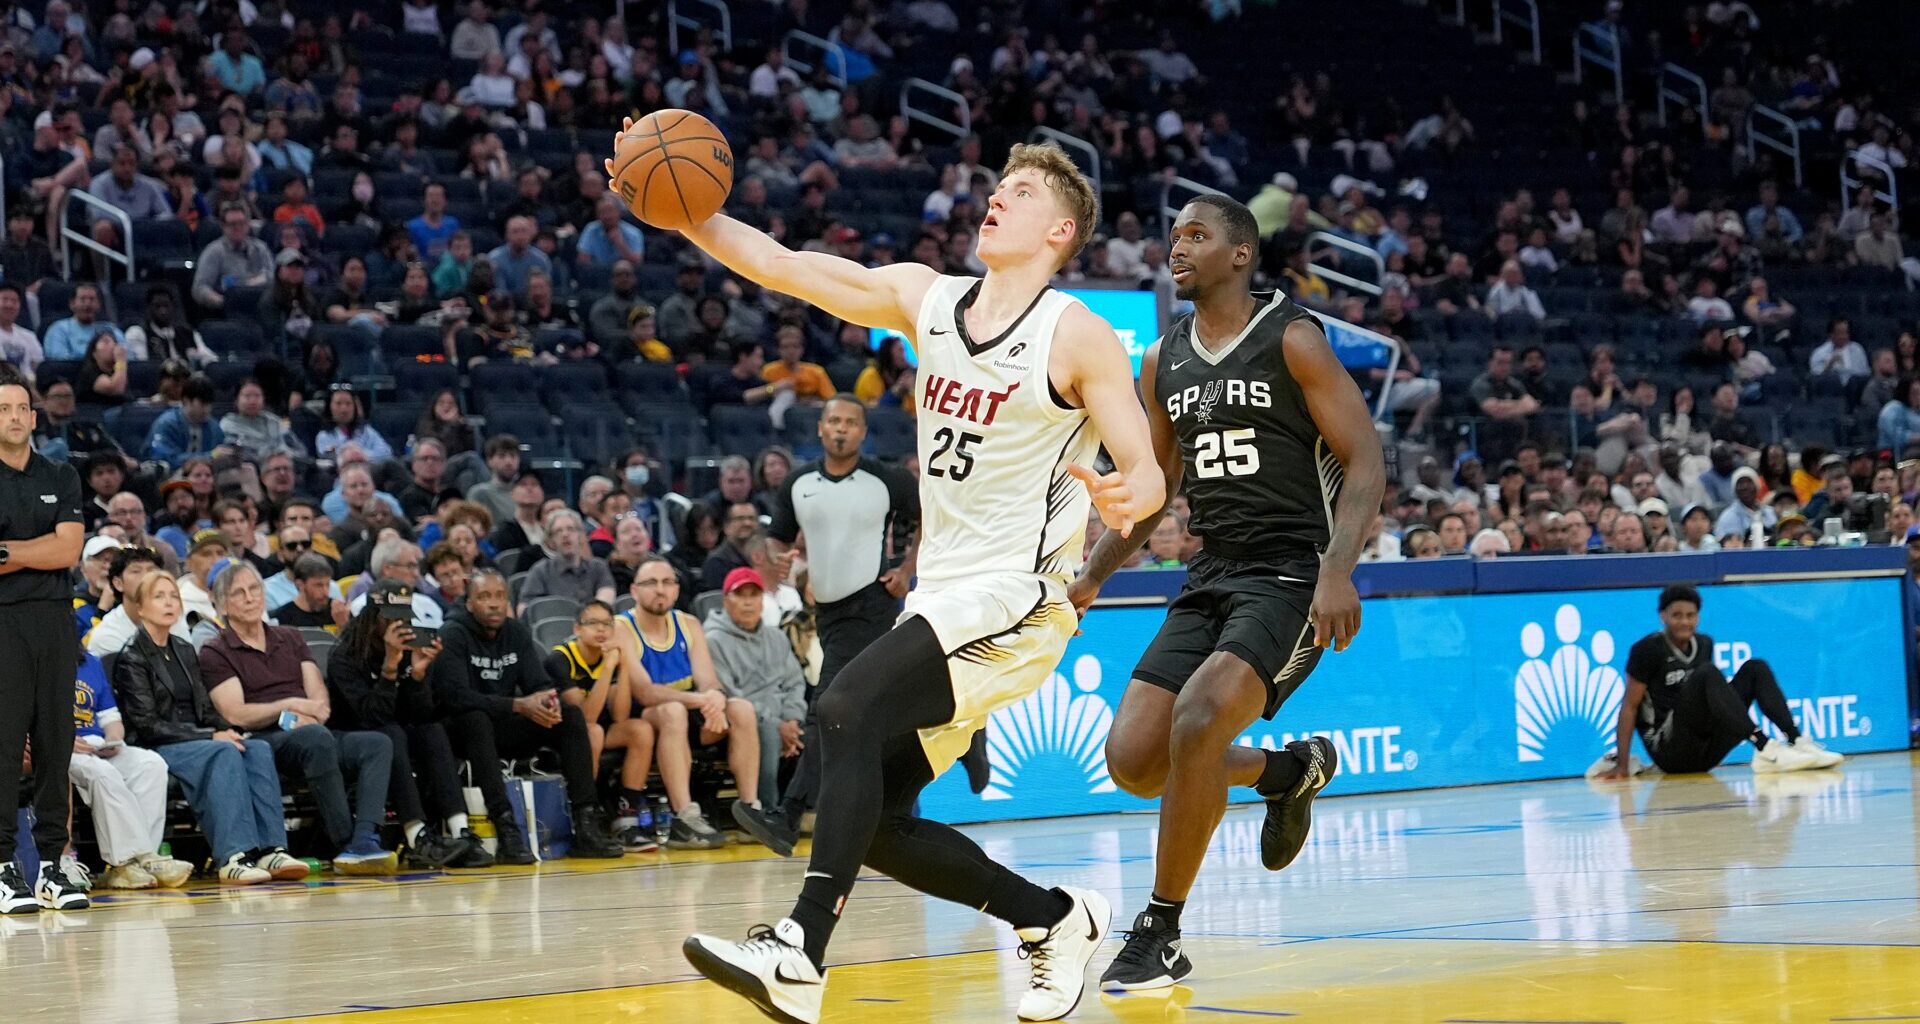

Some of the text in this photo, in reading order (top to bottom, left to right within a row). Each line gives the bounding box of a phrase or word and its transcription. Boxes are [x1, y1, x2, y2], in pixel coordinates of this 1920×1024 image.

[994, 360, 1029, 371] Robinhood
[923, 374, 1020, 426] HEAT
[1167, 379, 1272, 425] SPURS
[928, 426, 984, 481] 25
[1195, 427, 1260, 478] 25
